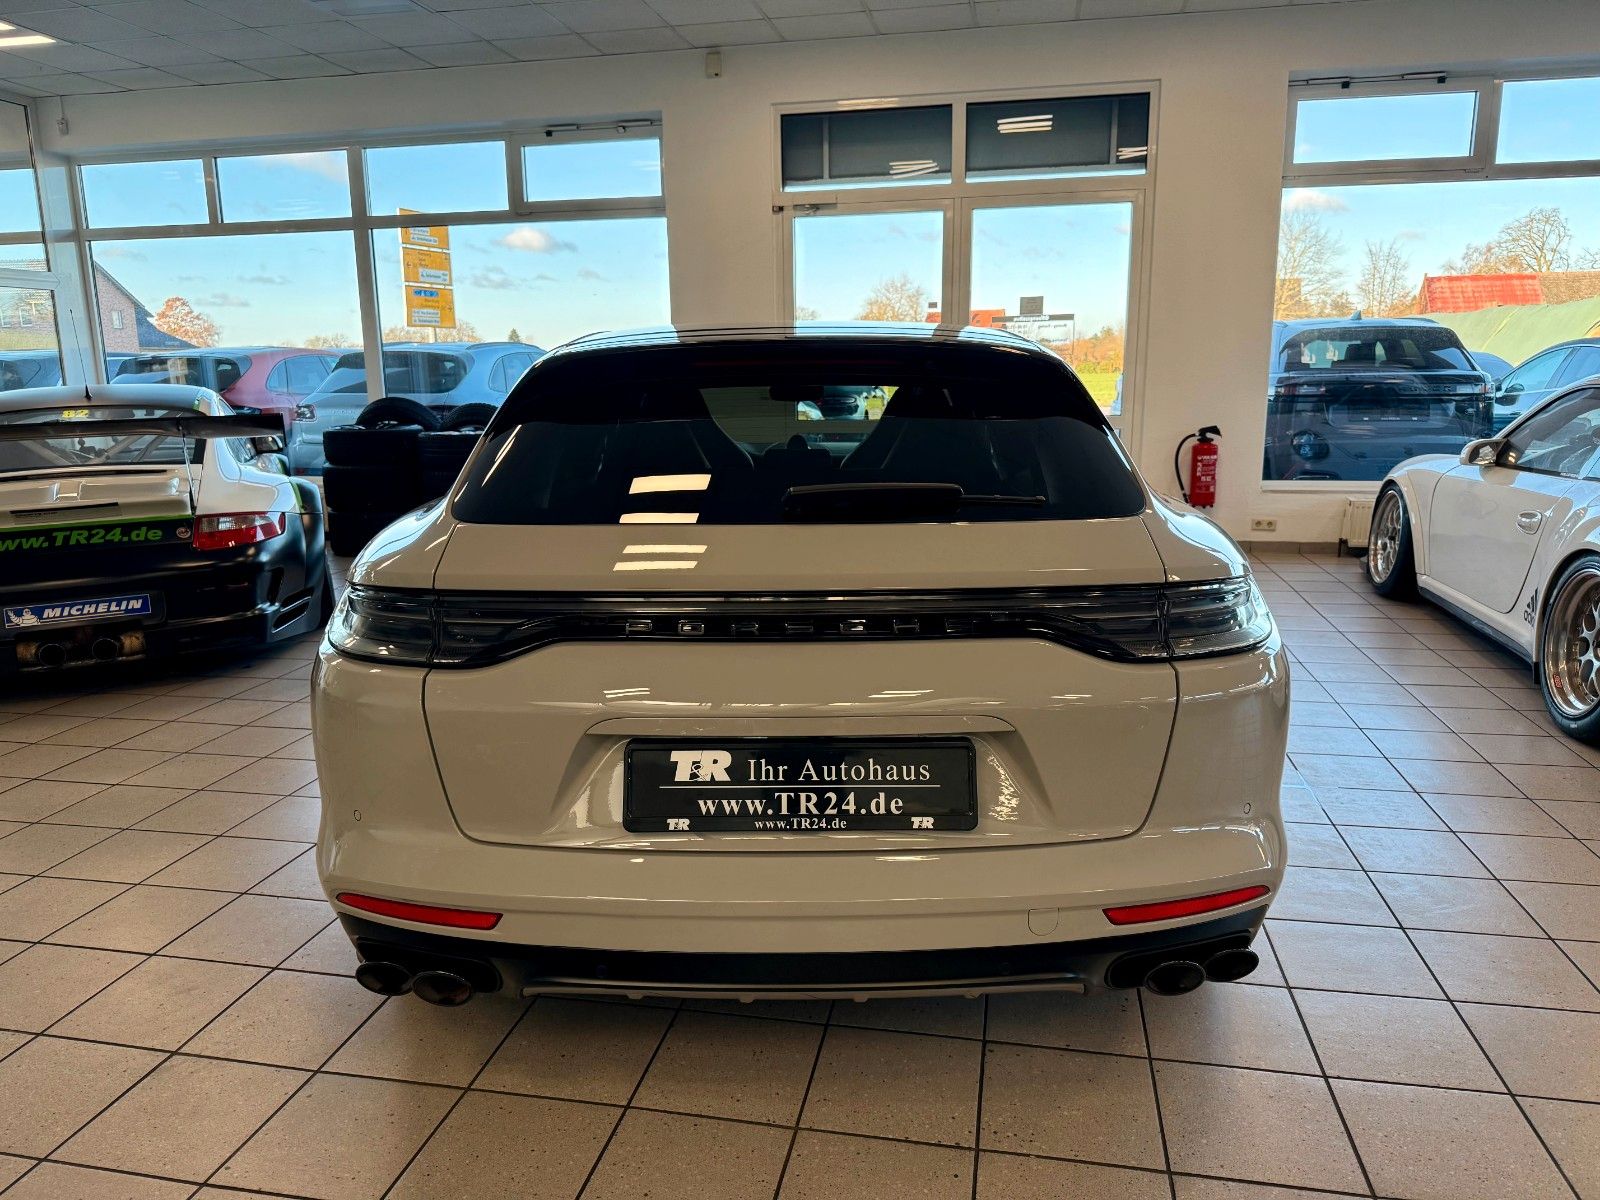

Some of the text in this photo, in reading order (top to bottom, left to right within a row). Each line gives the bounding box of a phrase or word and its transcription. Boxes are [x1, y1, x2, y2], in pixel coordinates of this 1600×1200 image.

[42, 599, 143, 619] MICHELIN
[747, 759, 788, 781] Ihr
[798, 758, 930, 781] Autohaus
[697, 792, 904, 815] www.TR24.de
[754, 817, 847, 830] www.TR24.de
